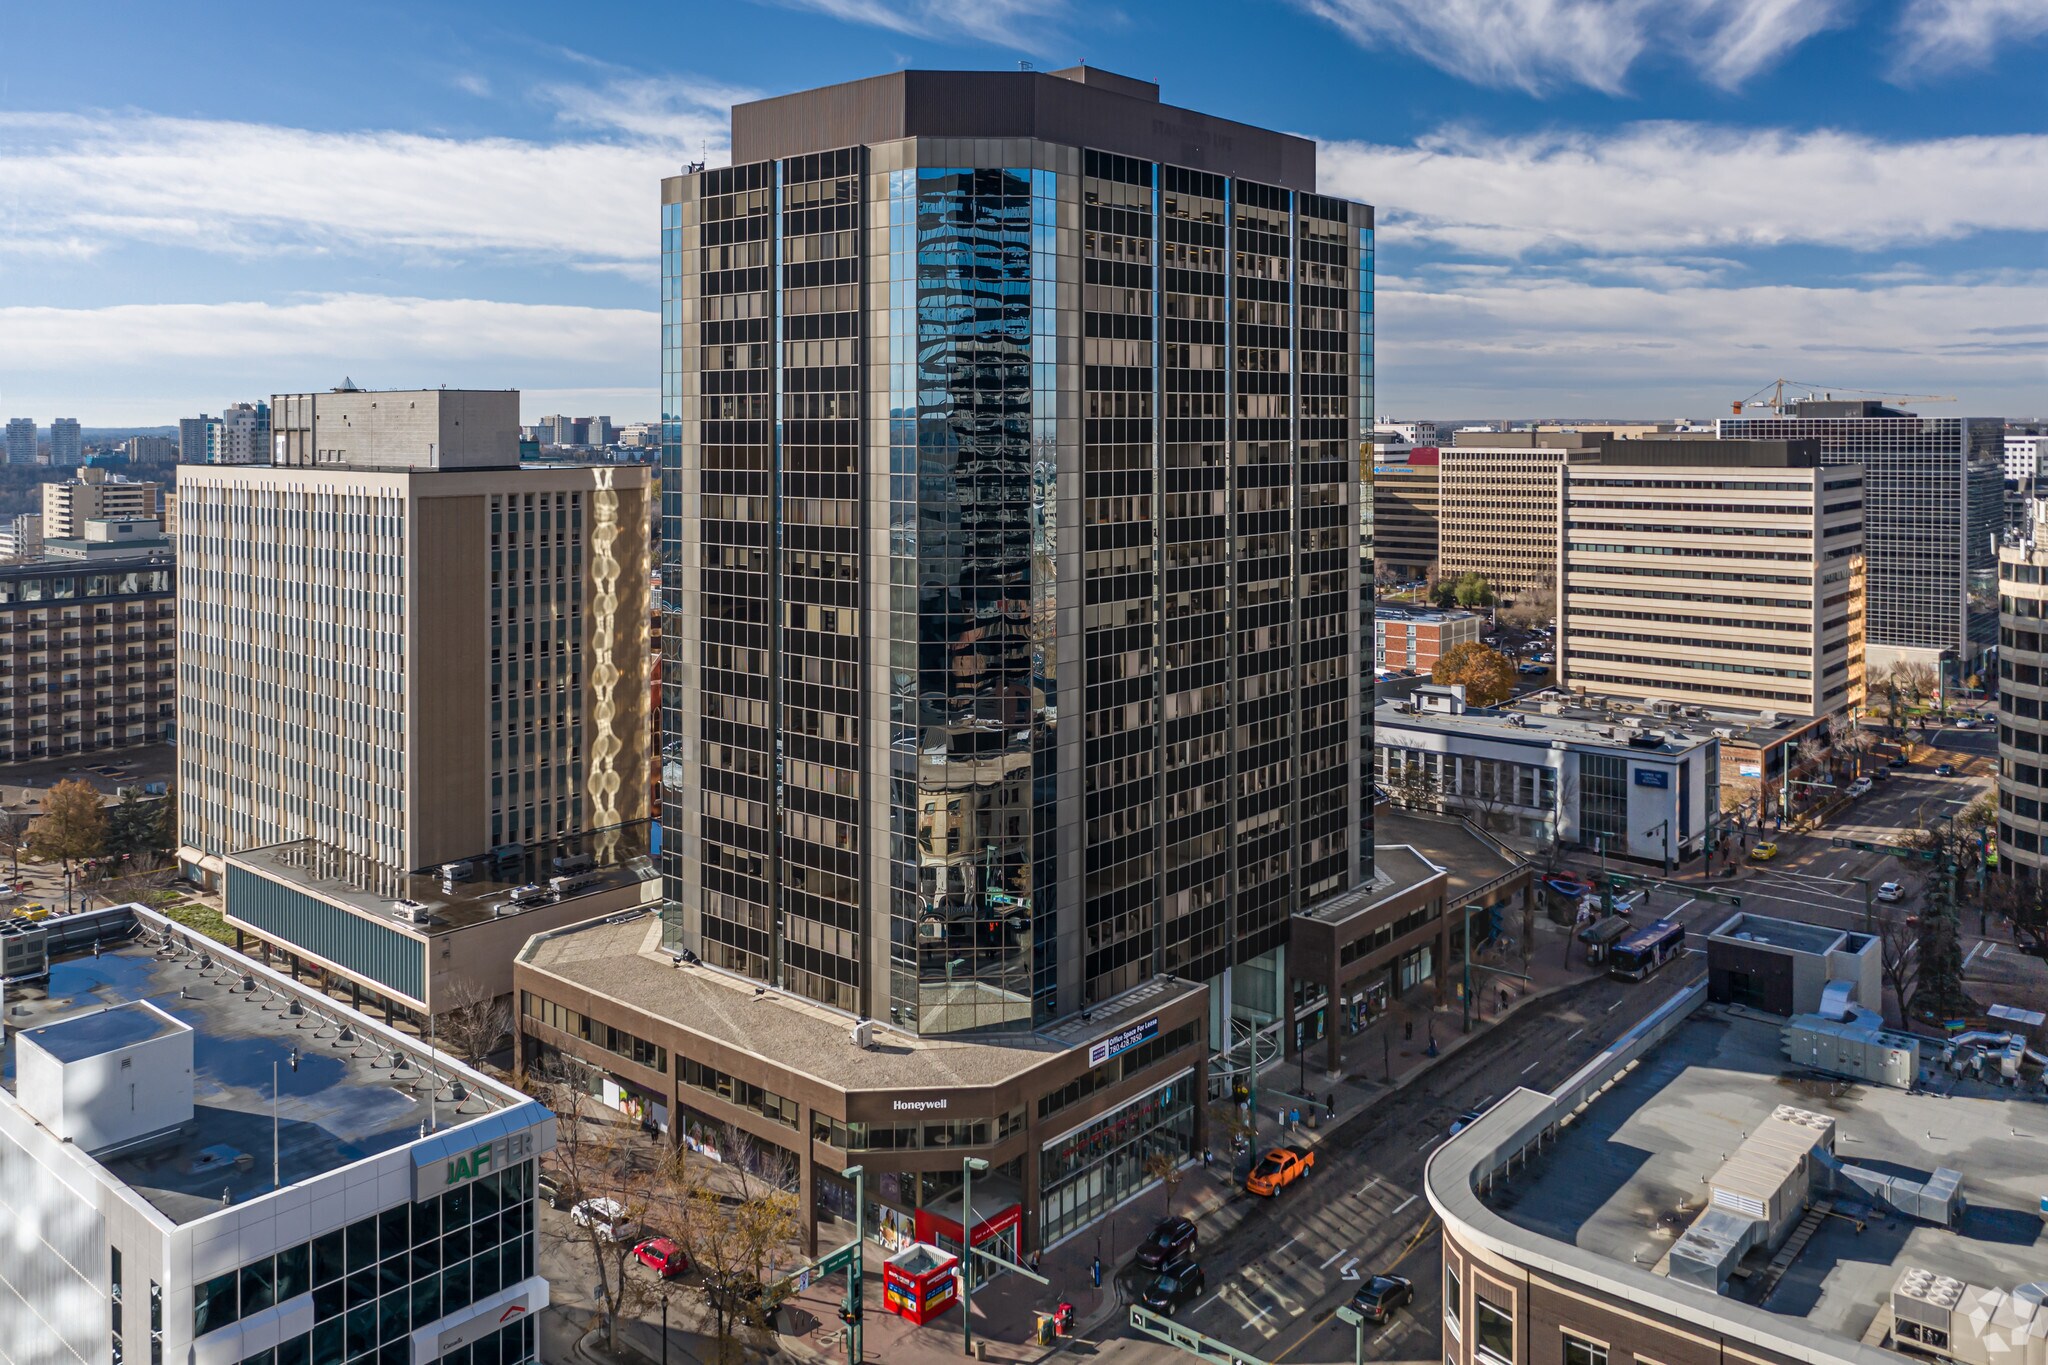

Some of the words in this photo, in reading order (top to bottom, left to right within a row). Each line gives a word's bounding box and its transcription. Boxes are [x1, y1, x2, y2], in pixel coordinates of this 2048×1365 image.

[1109, 1035, 1123, 1046] Office
[1123, 1029, 1137, 1039] Space
[1137, 1025, 1145, 1033] For
[1145, 1018, 1158, 1029] Lease
[1109, 1033, 1143, 1054] 780.428.7850
[893, 1099, 947, 1111] Honeywell
[447, 1131, 533, 1184] JAFFER
